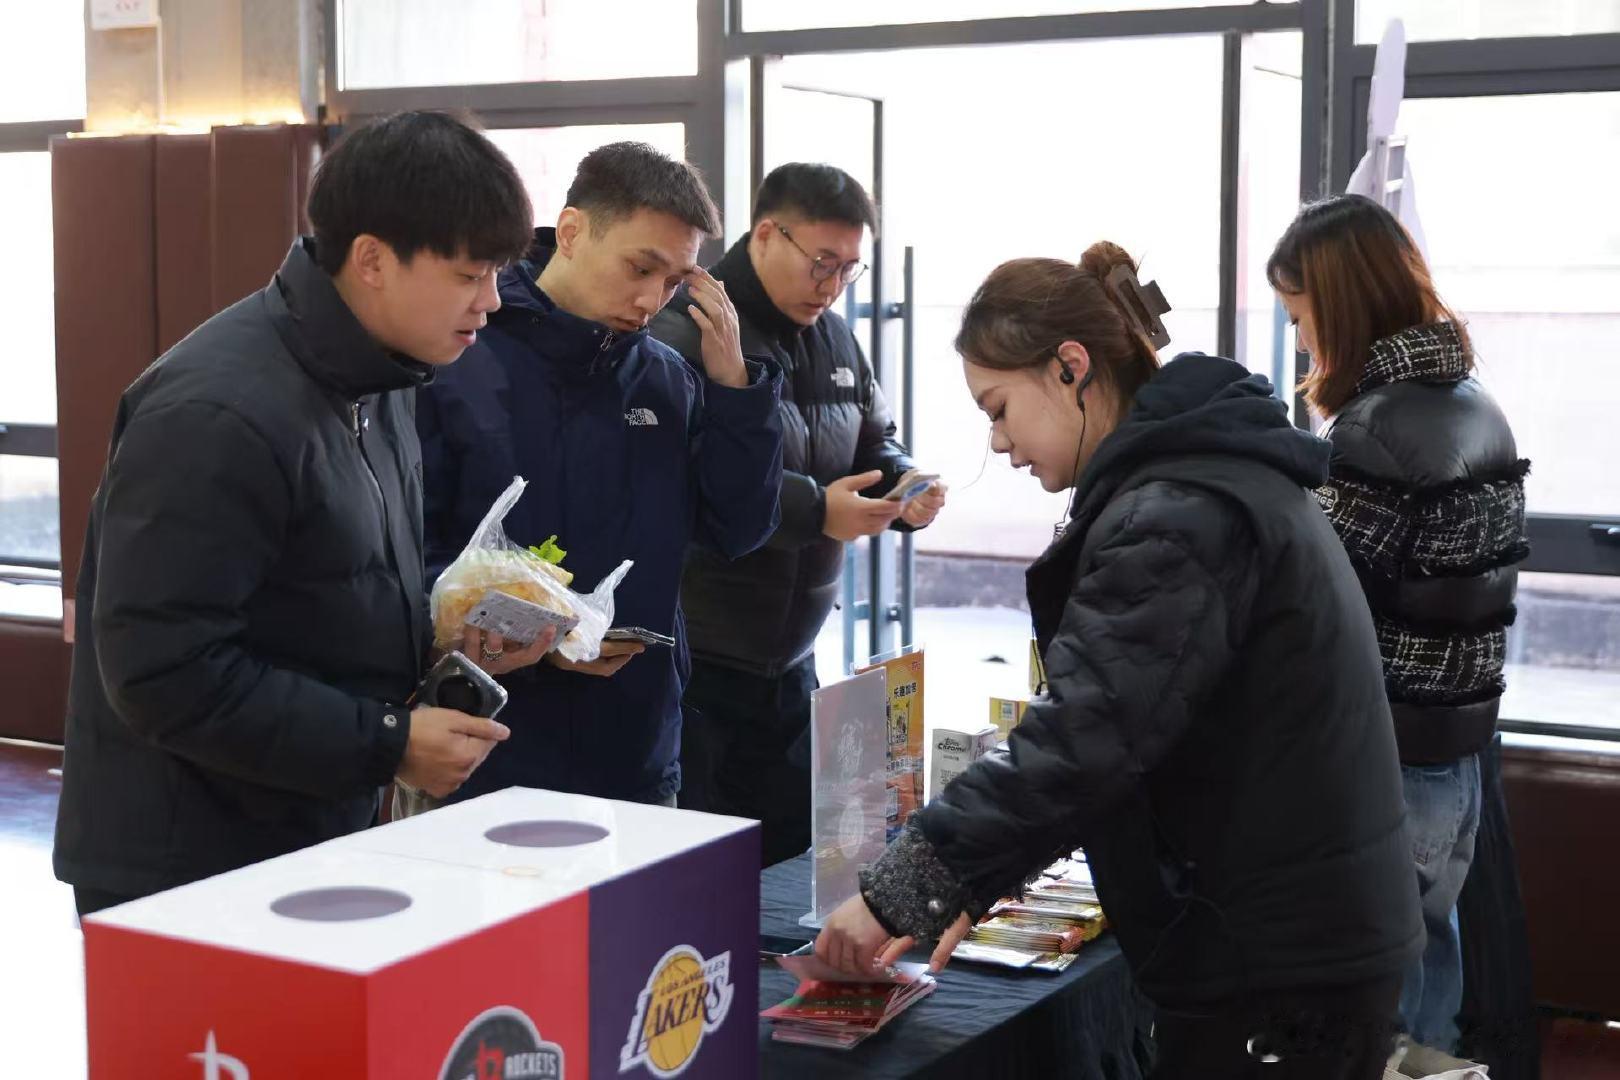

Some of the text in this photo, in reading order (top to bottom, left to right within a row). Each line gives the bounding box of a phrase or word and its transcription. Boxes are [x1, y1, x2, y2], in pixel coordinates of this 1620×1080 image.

[630, 408, 645, 416] THE
[628, 974, 725, 1061] LAKERS
[504, 1051, 557, 1080] ROCKETS
